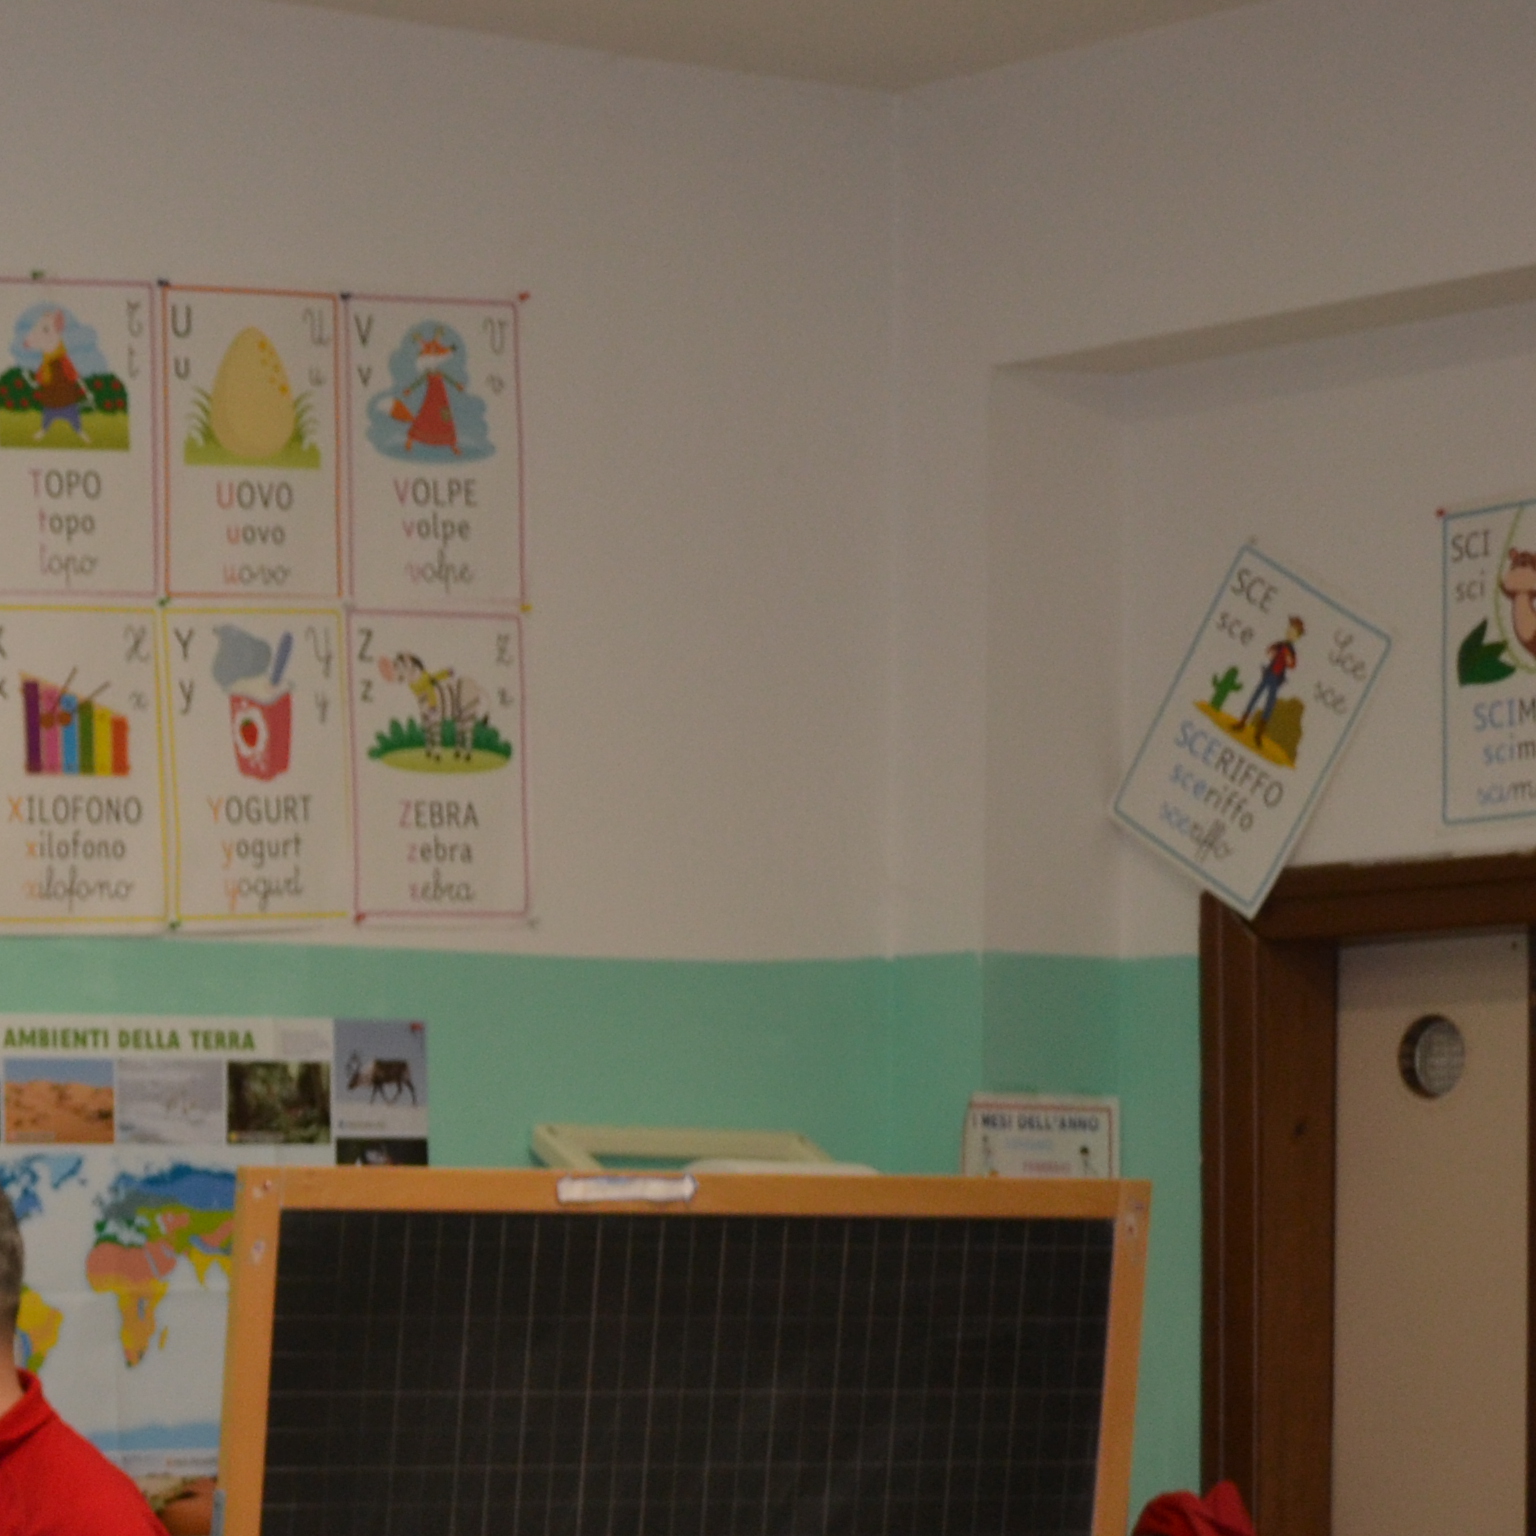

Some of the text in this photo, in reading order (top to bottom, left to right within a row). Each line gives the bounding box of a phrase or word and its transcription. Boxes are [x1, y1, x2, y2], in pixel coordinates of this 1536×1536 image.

[171, 306, 192, 339] U
[354, 315, 374, 348] V
[175, 358, 190, 380] u
[357, 366, 372, 388] v
[30, 468, 102, 500] TOPO
[216, 480, 294, 511] UOVO
[393, 477, 478, 508] VOLPE
[38, 509, 95, 541] topo
[227, 524, 286, 546] uovo
[402, 513, 471, 551] volpe
[1451, 529, 1491, 562] SCI
[1230, 567, 1279, 614] SCE
[174, 628, 195, 661] Y
[357, 627, 375, 662] Z
[1215, 610, 1256, 648] sce
[179, 681, 195, 716] y
[1174, 720, 1285, 809] SCERIFFO
[8, 794, 143, 827] XILOFONO
[207, 795, 312, 826] YOGURT
[398, 799, 479, 829] ZEBRA
[26, 829, 126, 862] xilofono
[221, 831, 302, 870] yogurt
[406, 835, 473, 865] zebra
[3, 1028, 109, 1049] AMBIENTI
[118, 1029, 180, 1050] DELLA
[189, 1030, 256, 1051] TERRA
